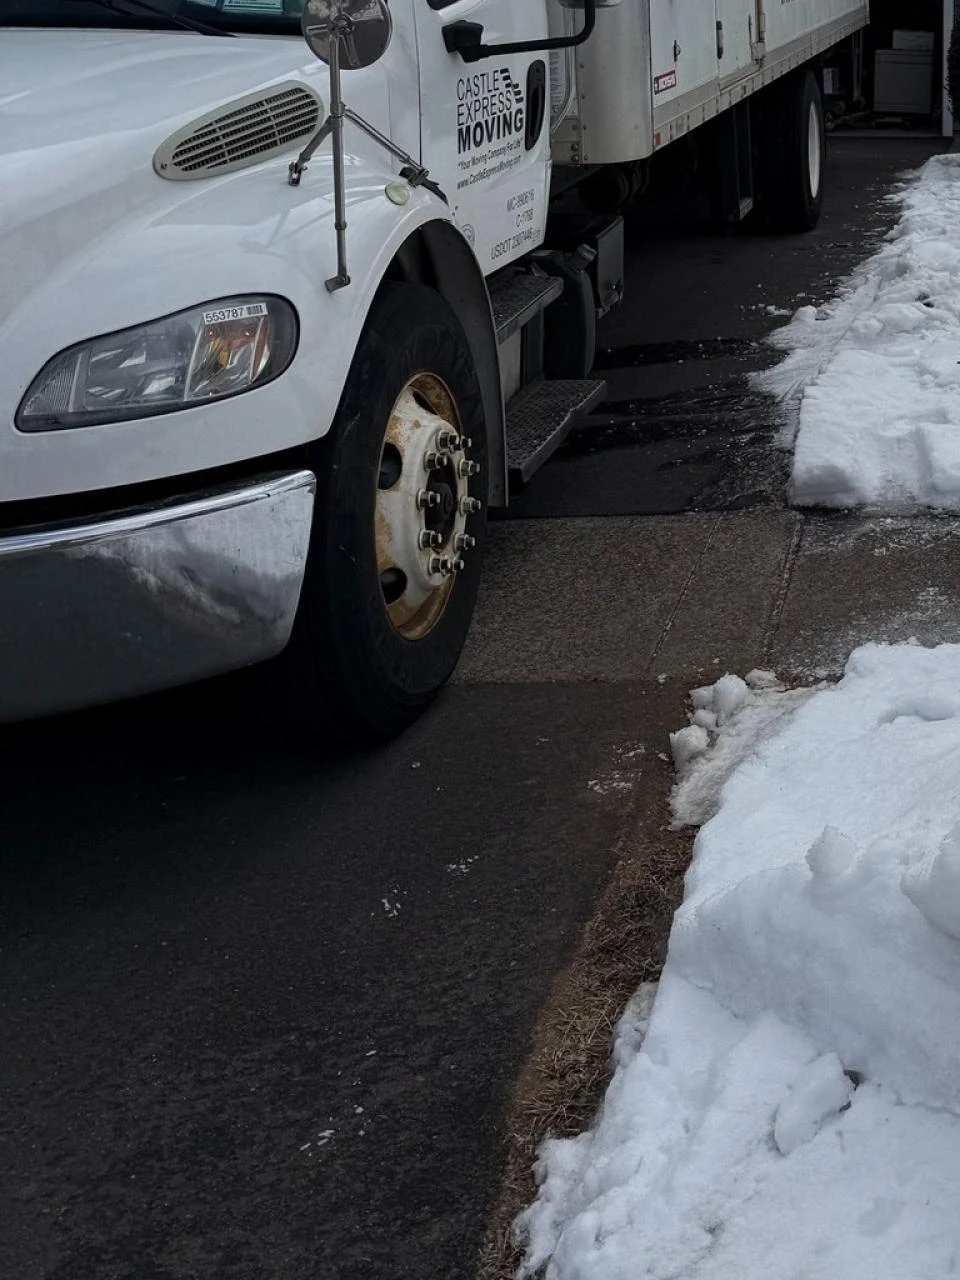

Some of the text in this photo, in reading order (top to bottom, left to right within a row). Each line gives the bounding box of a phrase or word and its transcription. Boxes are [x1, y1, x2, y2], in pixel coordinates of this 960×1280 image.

[457, 70, 500, 101] CASTLE
[457, 90, 512, 126] EXPRESS
[458, 107, 524, 154] MOVING
[205, 306, 244, 323] 553787
